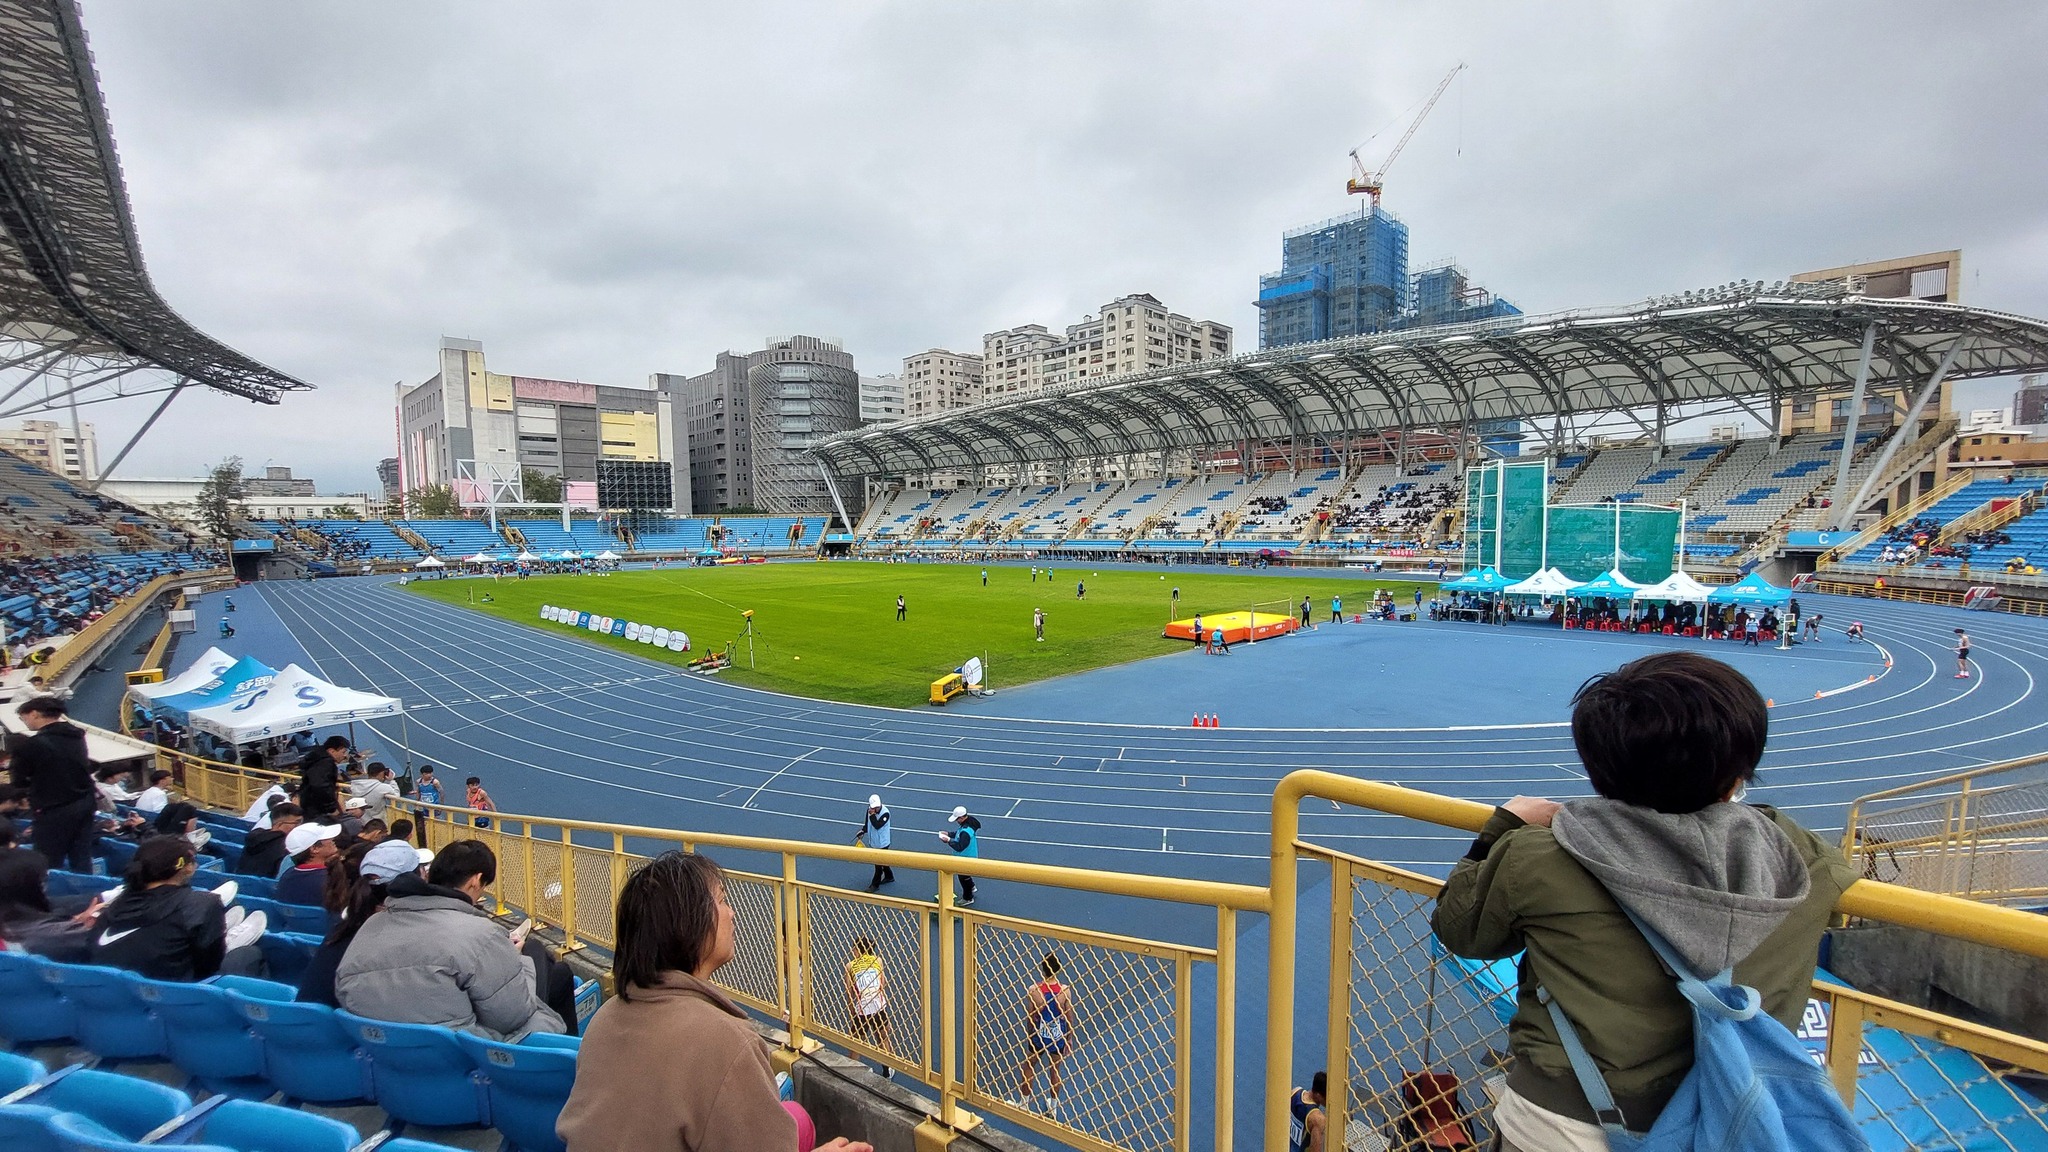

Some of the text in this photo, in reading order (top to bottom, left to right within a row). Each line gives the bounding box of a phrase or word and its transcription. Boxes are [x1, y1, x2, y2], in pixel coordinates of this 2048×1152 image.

[250, 540, 258, 548] A
[1818, 533, 1829, 544] C
[493, 1051, 508, 1064] 13
